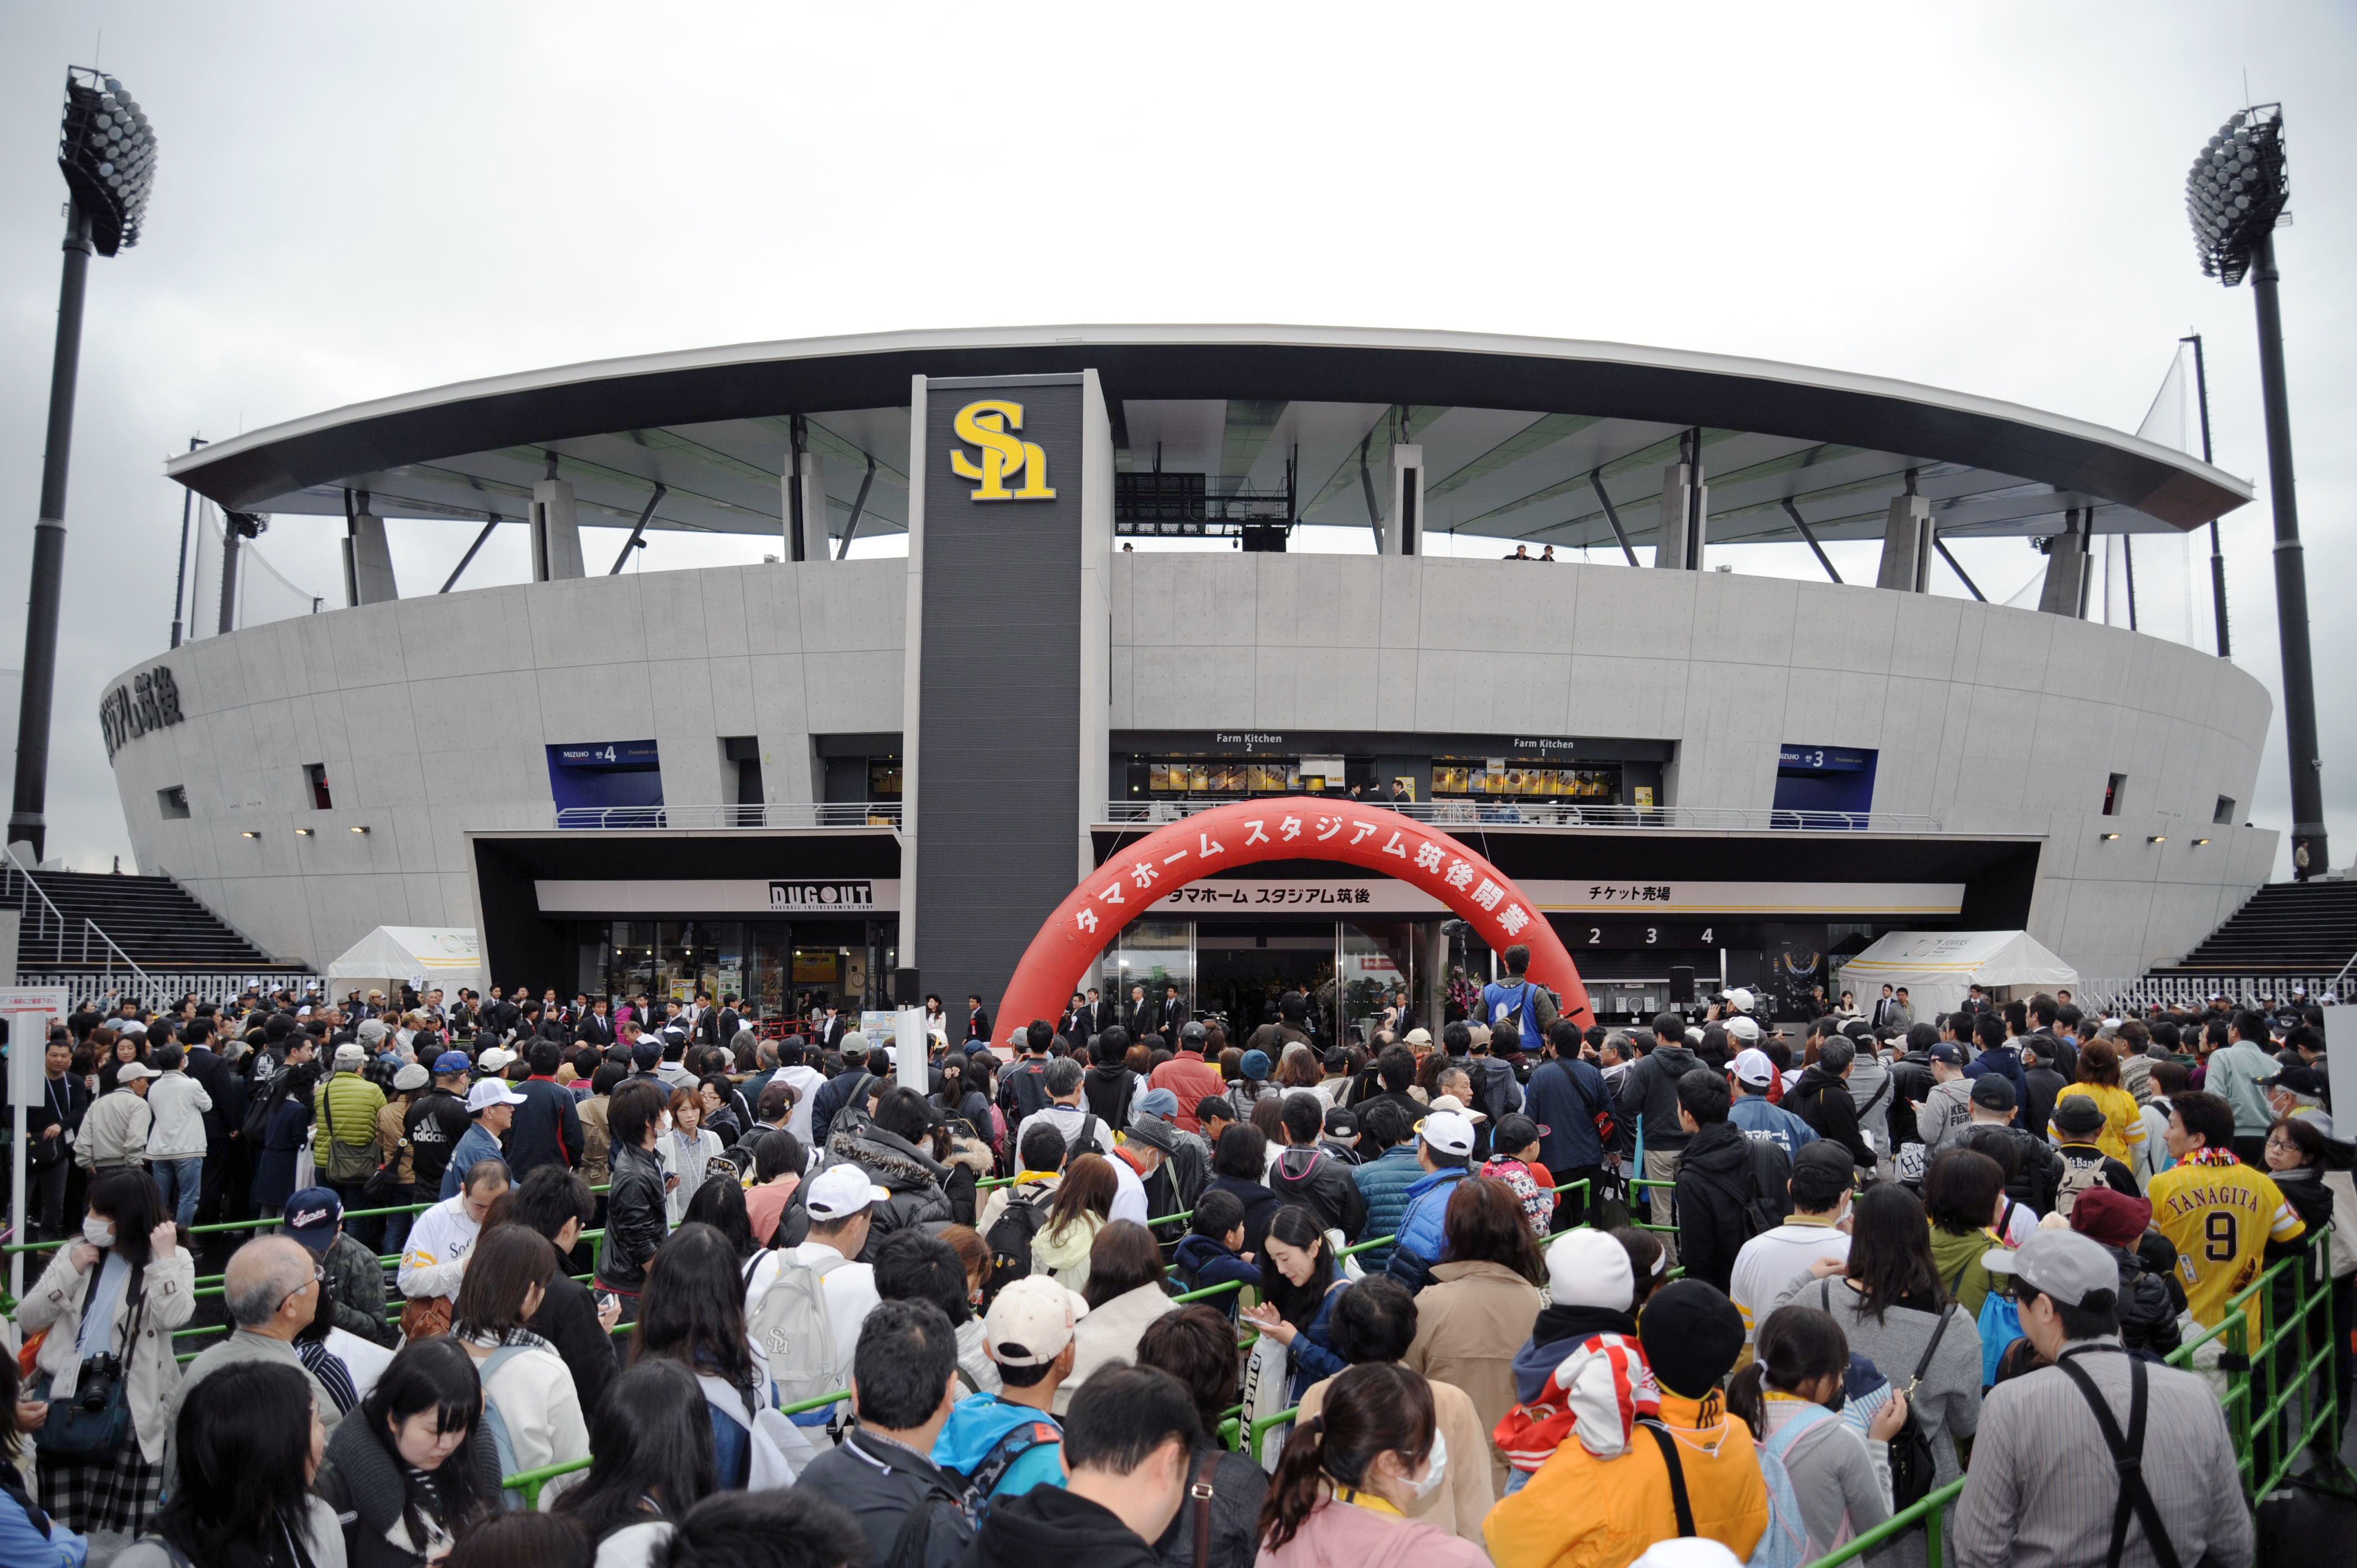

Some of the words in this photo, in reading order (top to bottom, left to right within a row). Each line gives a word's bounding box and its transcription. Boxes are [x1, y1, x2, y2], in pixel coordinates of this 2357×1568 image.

[1217, 734, 1241, 742] Farm
[1244, 734, 1282, 742] Kitchen
[1514, 739, 1537, 747] Farm
[1540, 739, 1573, 749] Kitchen
[604, 746, 616, 762] 4
[1246, 743, 1252, 751] 2
[1813, 751, 1824, 767] 3
[1075, 833, 1224, 933] タマホーム
[1244, 816, 1530, 936] スタジアム筑後開業
[771, 886, 869, 904] DUGOUT
[1168, 888, 1248, 904] タマホーム
[1255, 888, 1370, 904] スタジアム筑後
[1589, 886, 1670, 901] チケット売場
[1589, 928, 1601, 943] 2
[1645, 928, 1657, 943] 3
[1701, 928, 1713, 943] 4
[413, 1130, 447, 1143] adidas
[2168, 1186, 2258, 1215] YANAGITA
[292, 1209, 327, 1226] Japan
[2205, 1211, 2236, 1262] 9
